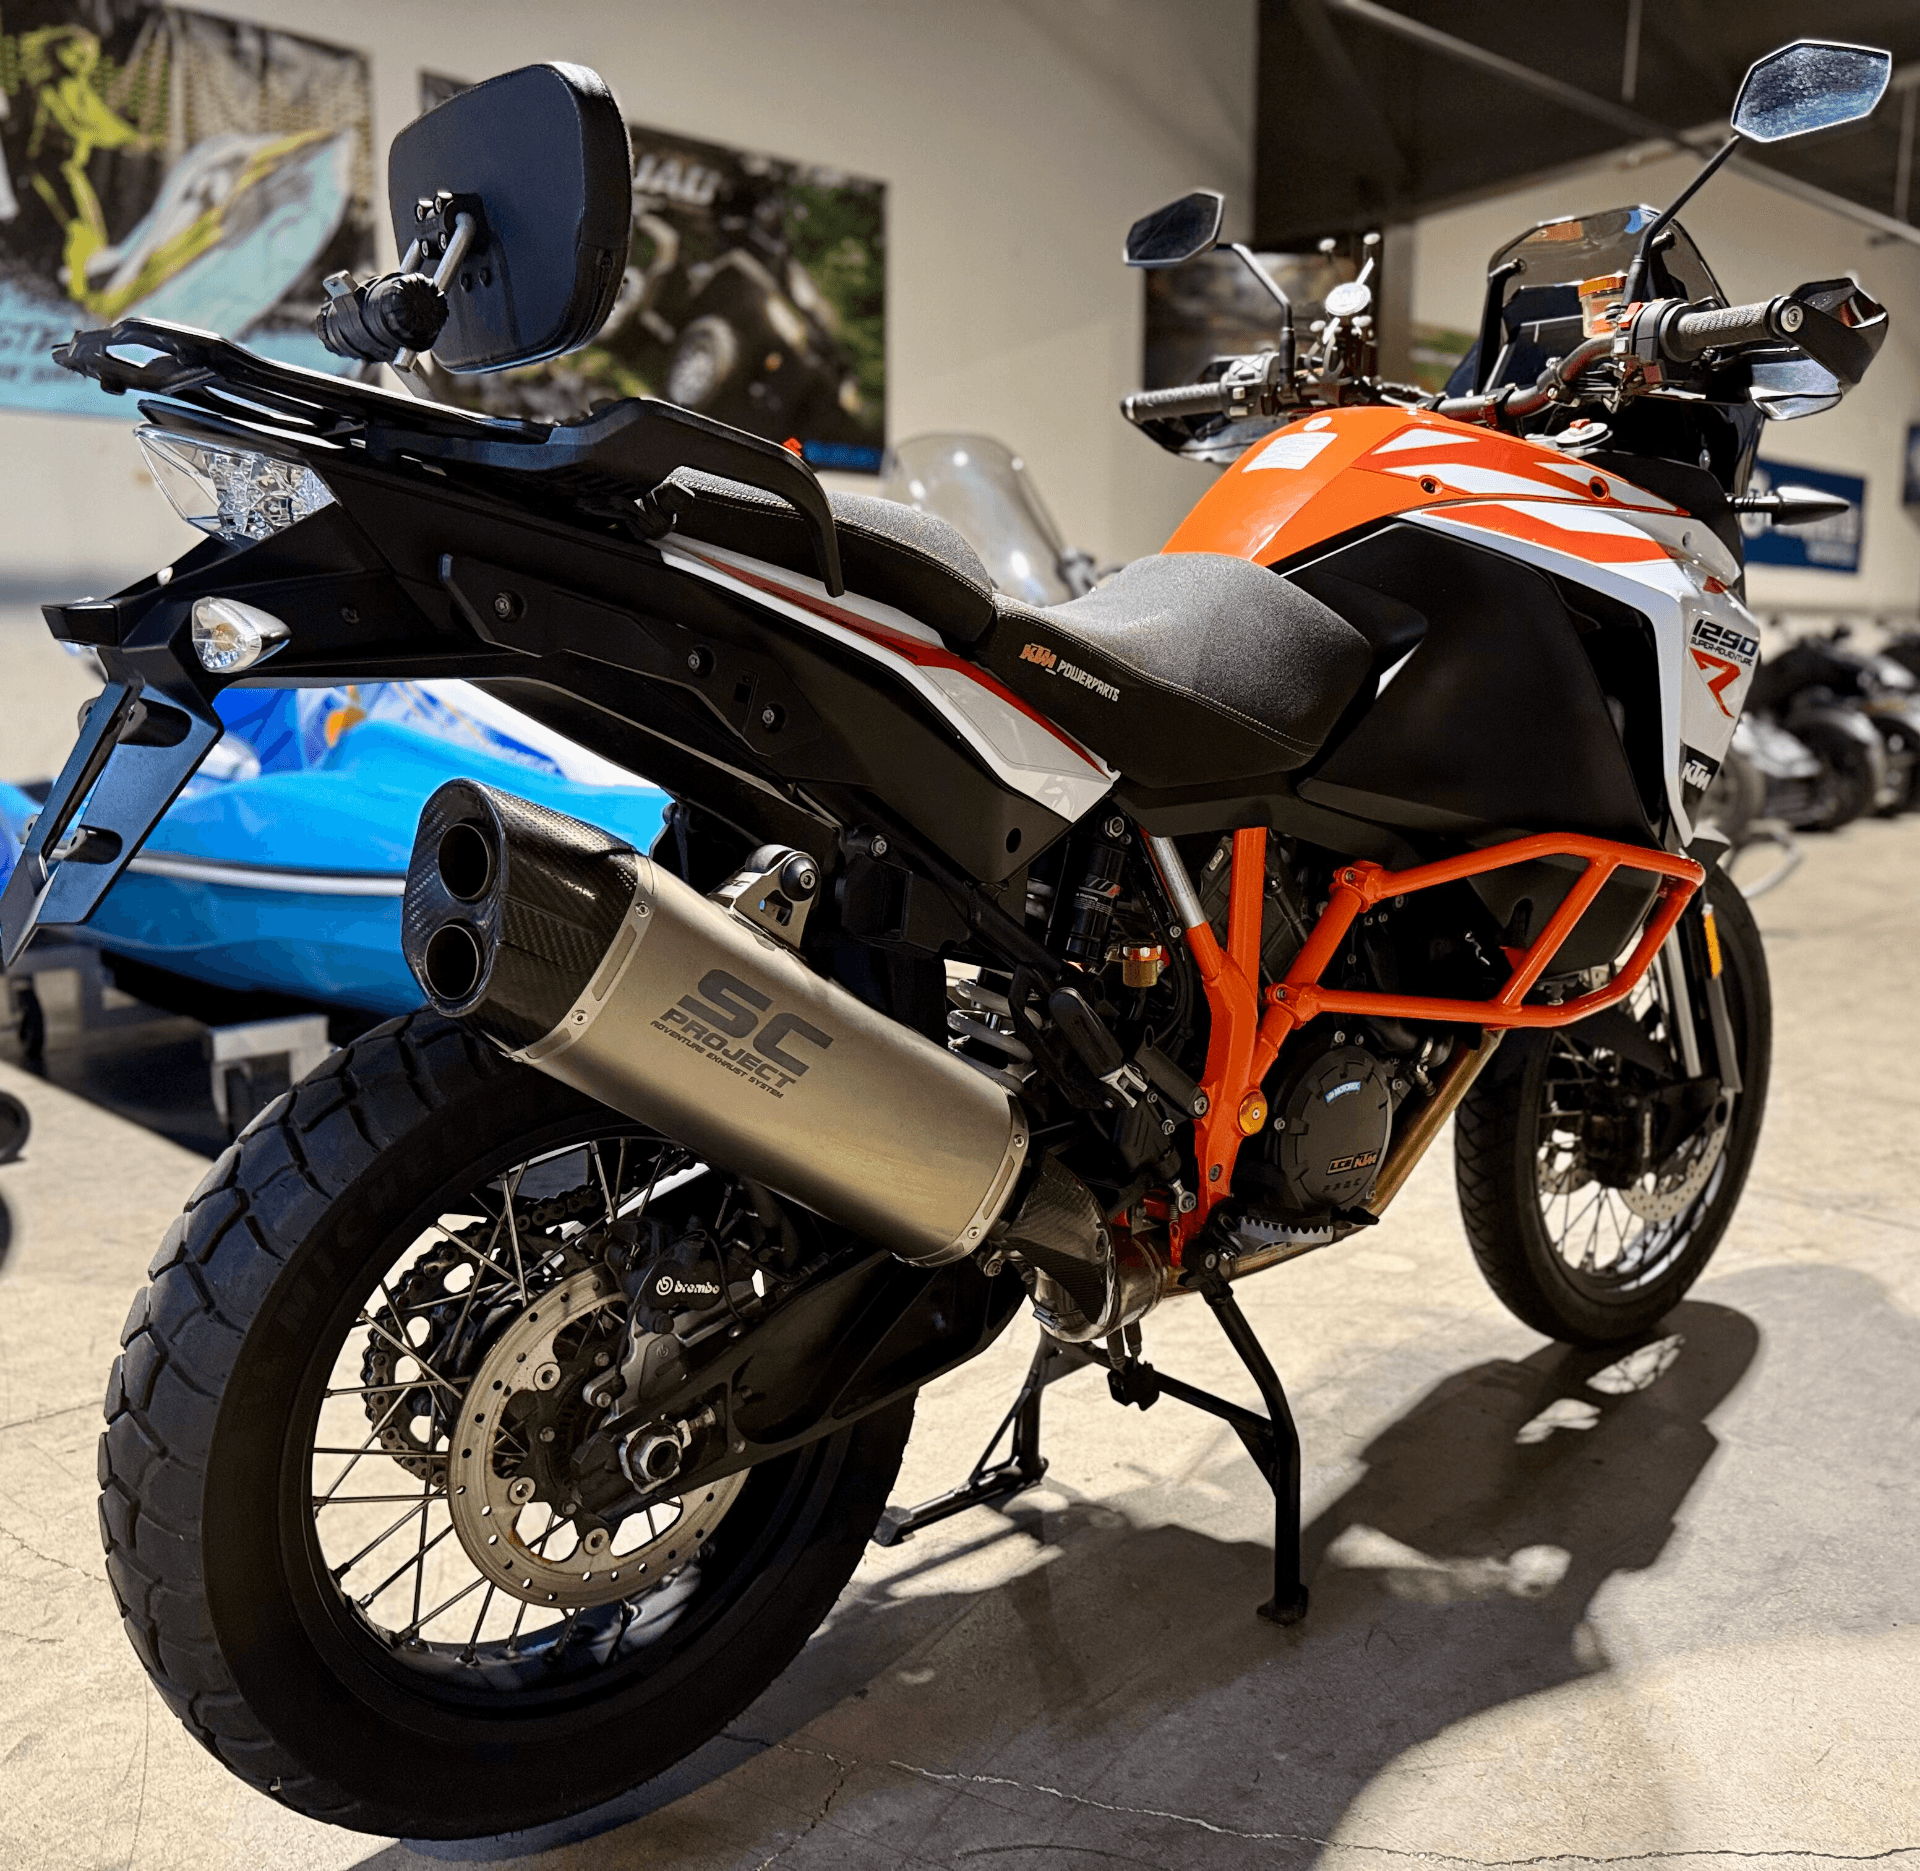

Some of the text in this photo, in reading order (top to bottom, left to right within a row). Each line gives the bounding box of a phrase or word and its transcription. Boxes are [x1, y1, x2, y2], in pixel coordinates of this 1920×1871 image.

[1692, 618, 1758, 657] 1290
[1019, 643, 1120, 702] KTM POWERPARTS
[1681, 759, 1713, 791] KTM
[676, 968, 834, 1078] SC
[650, 1020, 784, 1099] ADVENTURE EXHAUST SYSTEM
[659, 1007, 797, 1089] PROJECT
[1354, 1152, 1378, 1168] KTM
[674, 1280, 720, 1294] brembo
